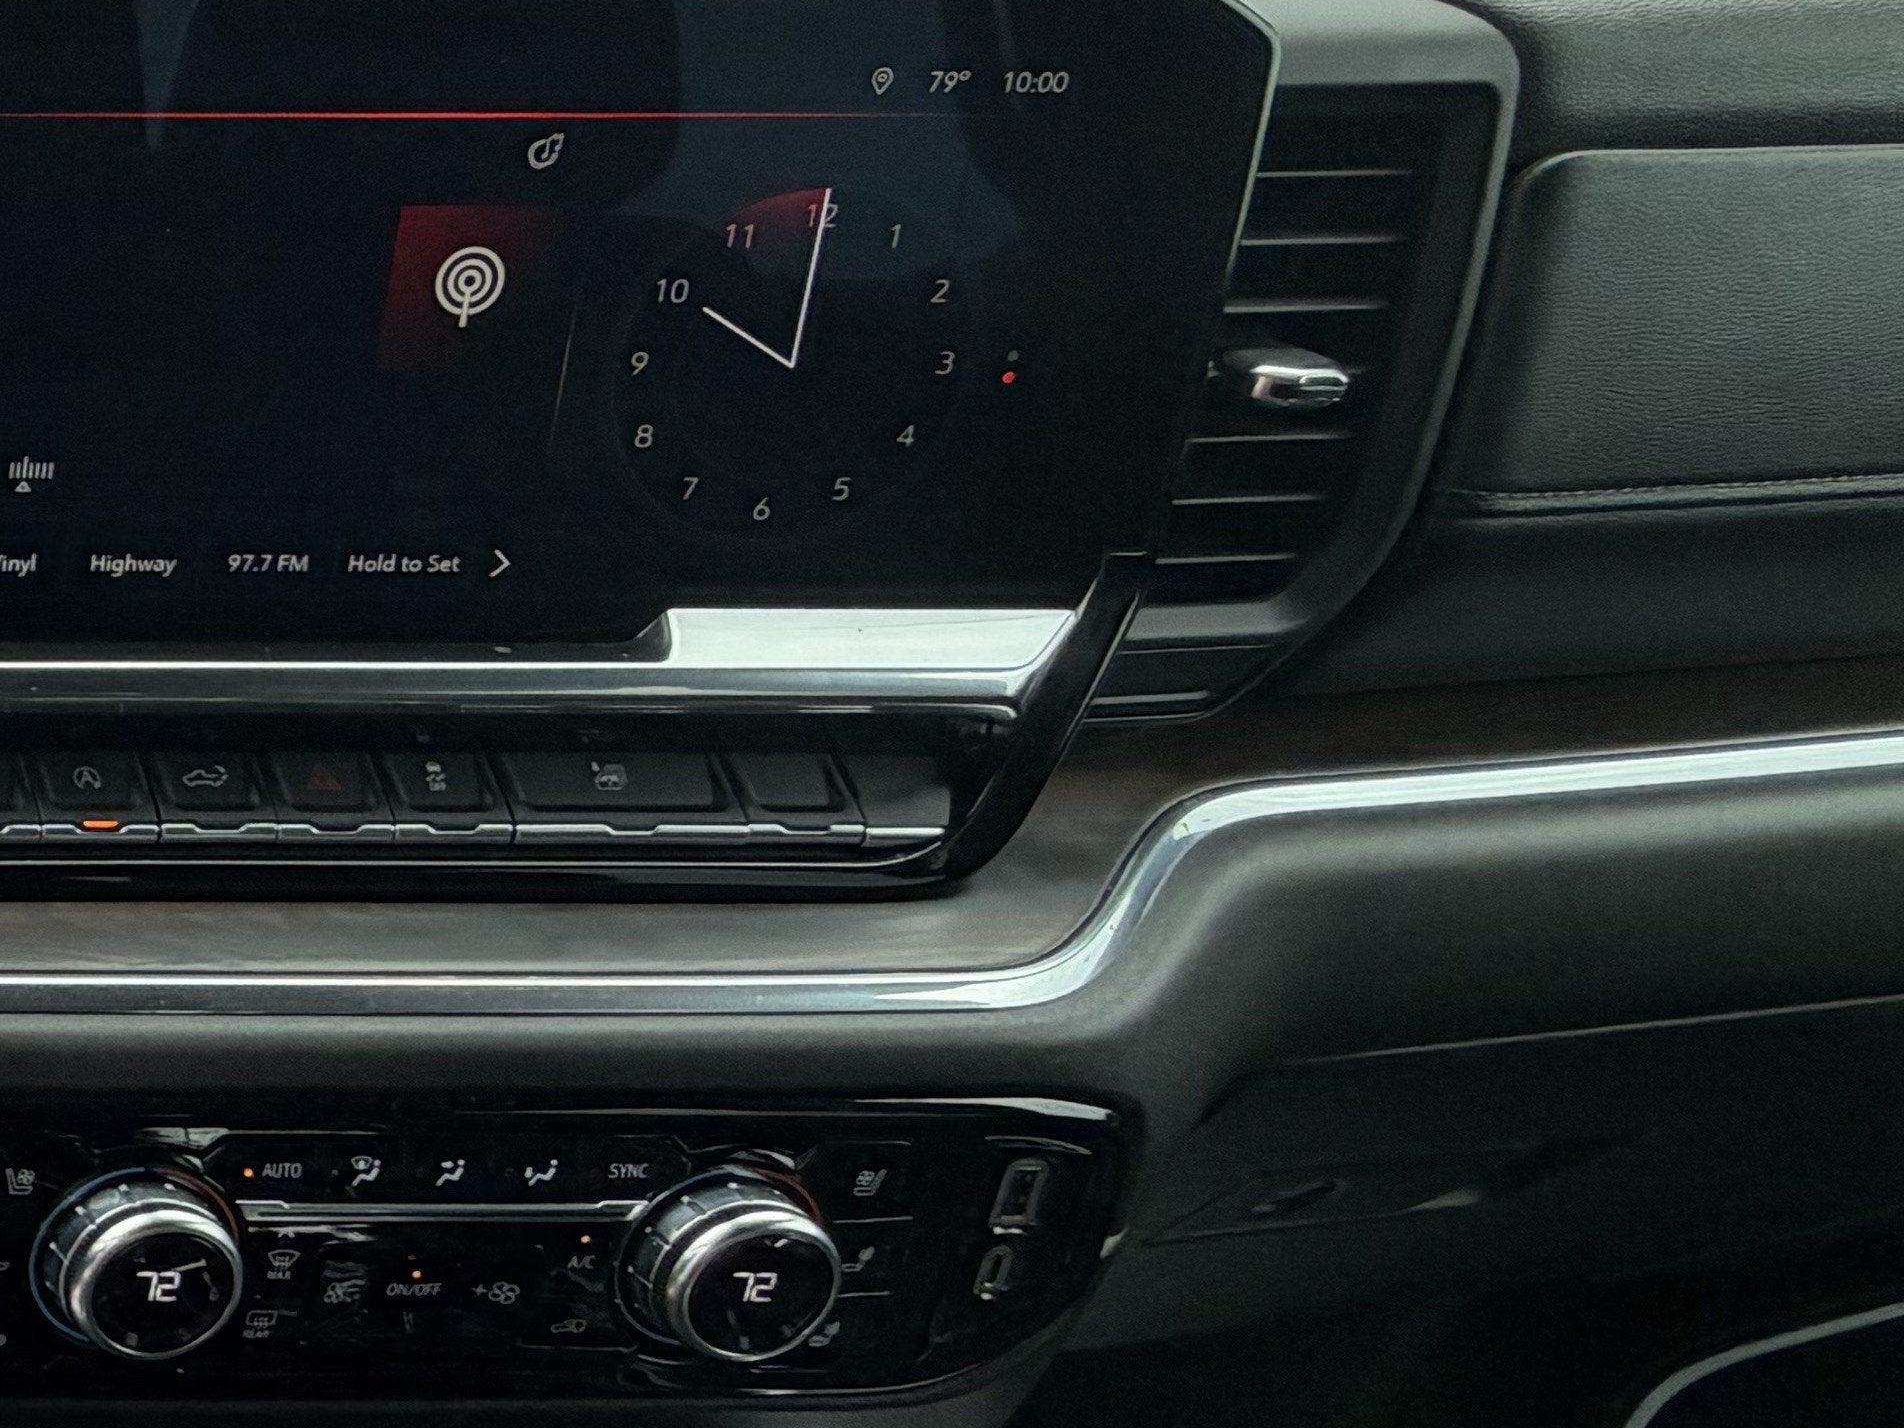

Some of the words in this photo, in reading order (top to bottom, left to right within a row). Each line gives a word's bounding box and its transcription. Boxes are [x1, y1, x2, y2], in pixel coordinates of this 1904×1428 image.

[928, 70, 972, 94] 79°
[1003, 69, 1070, 94] 10:00
[725, 223, 755, 249] 11
[891, 223, 902, 248] 1
[656, 277, 690, 303] 10
[930, 279, 951, 303] 2
[630, 351, 650, 375] 9
[935, 351, 956, 375] 3
[633, 423, 654, 449] 8
[896, 425, 916, 447] 4
[682, 477, 700, 500] 7
[831, 477, 852, 501] 5
[752, 497, 771, 521] 6
[90, 554, 177, 578] Highway
[227, 554, 273, 573] 97.7
[277, 554, 310, 573] FM
[347, 554, 396, 573] Hold
[401, 555, 423, 573] to
[427, 554, 462, 573] Set
[262, 1162, 303, 1179] AUTO
[607, 1163, 650, 1179] SYNC
[568, 1254, 596, 1270] A/C
[136, 1271, 182, 1302] 72
[386, 1282, 443, 1297] ON/OFF
[733, 1271, 778, 1302] 72
